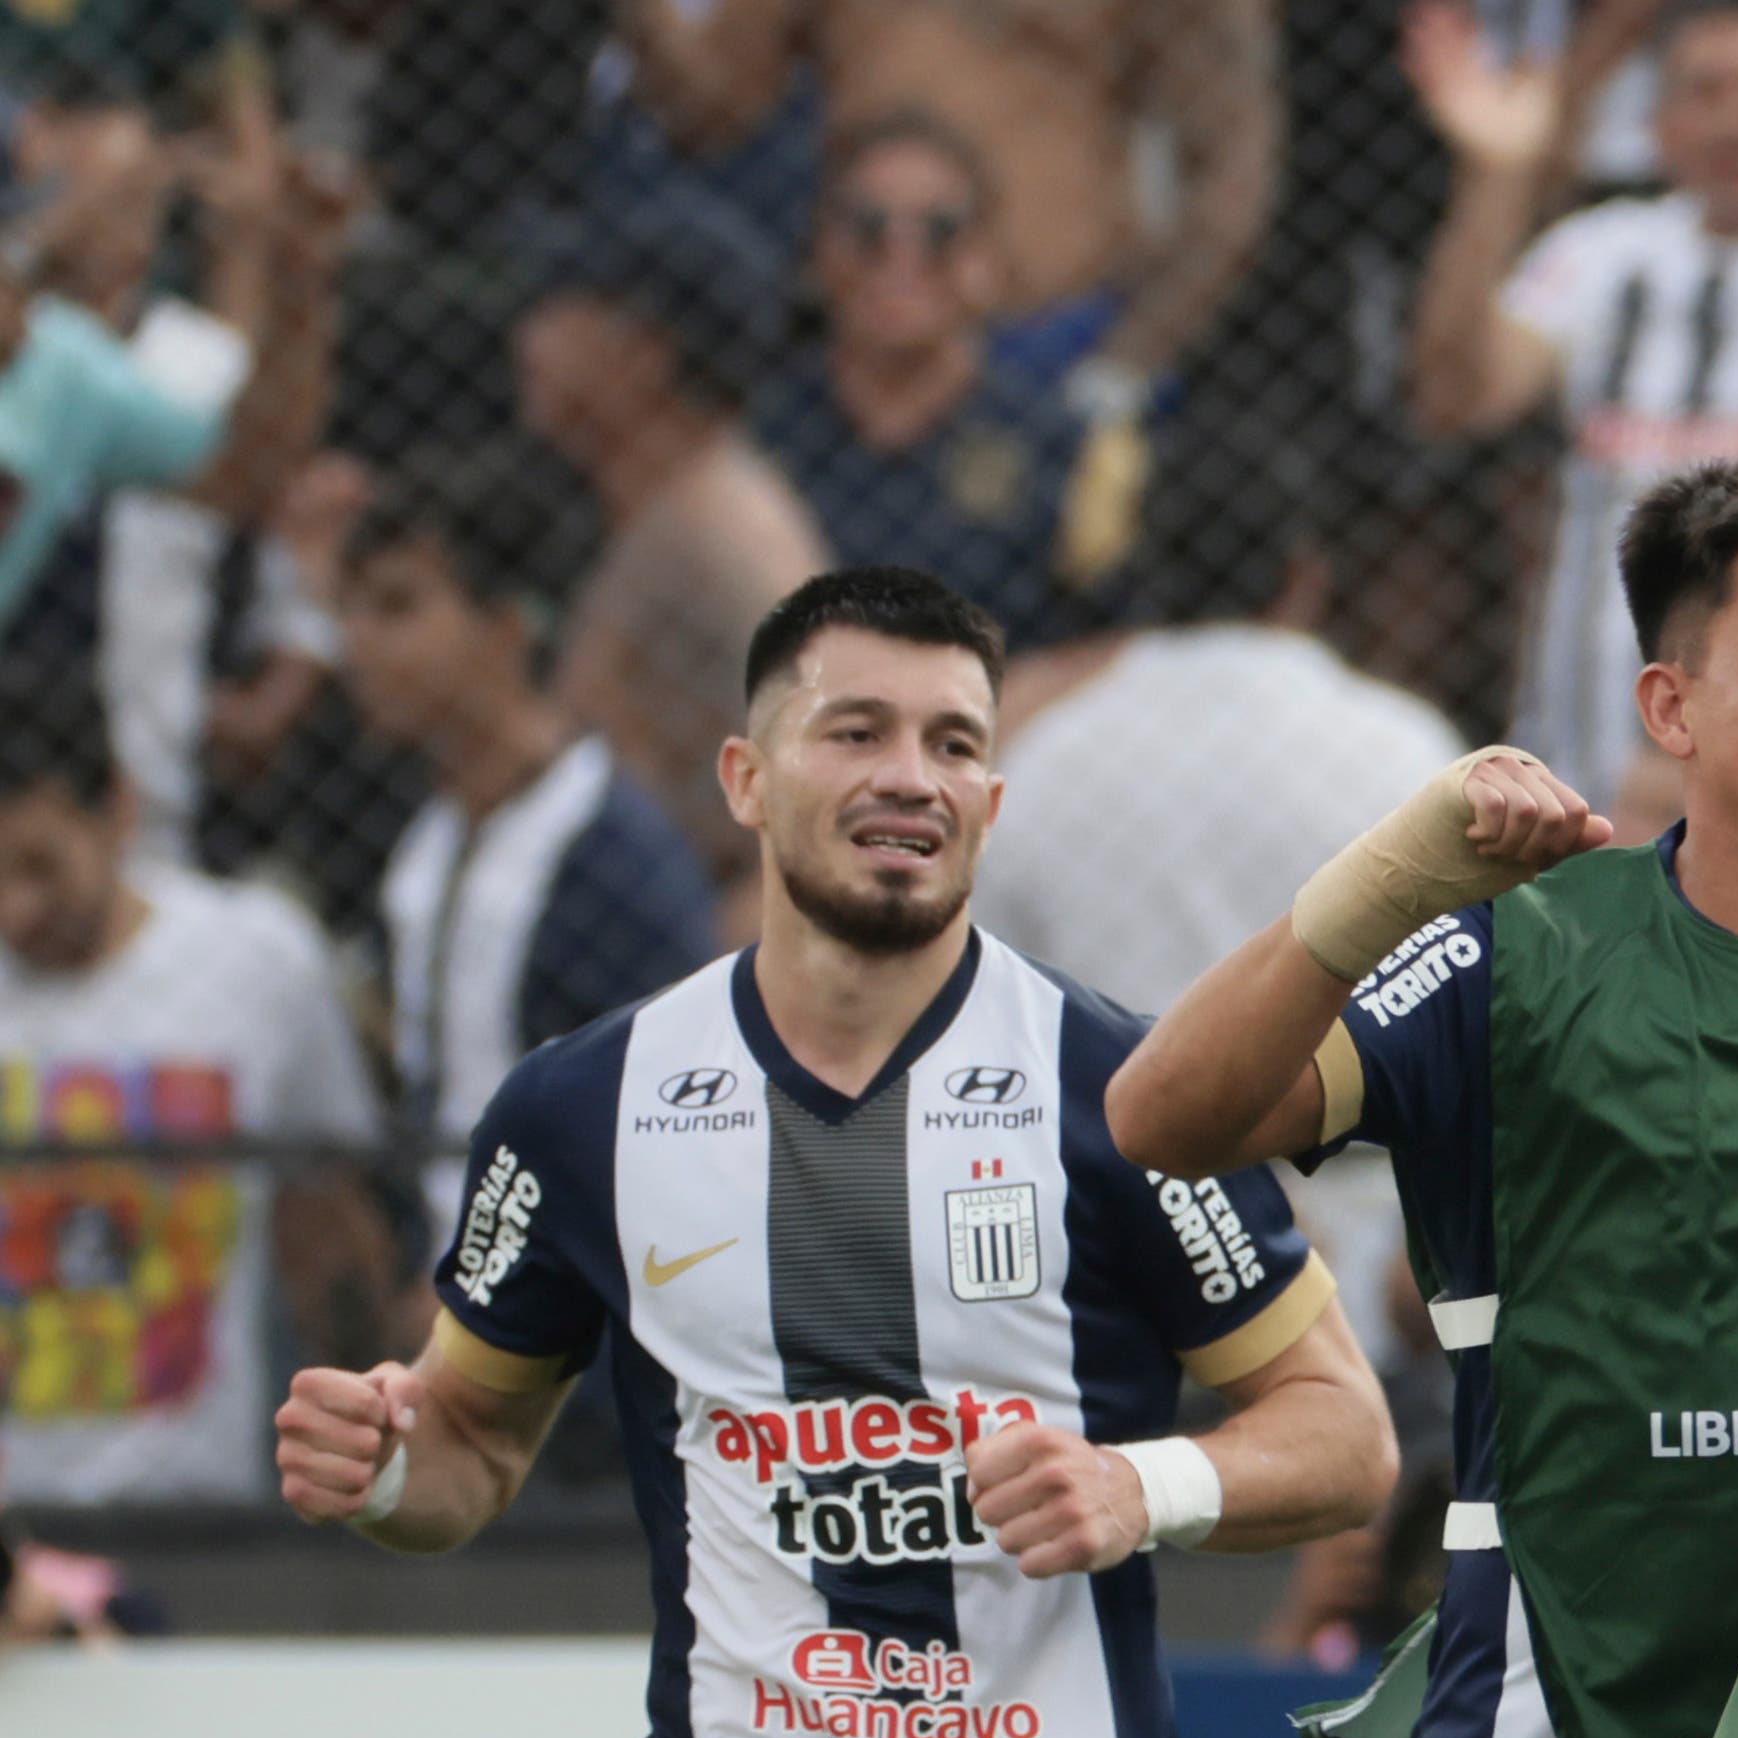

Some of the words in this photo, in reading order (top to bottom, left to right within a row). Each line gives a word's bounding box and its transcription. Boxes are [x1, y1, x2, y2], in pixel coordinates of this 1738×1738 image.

[1357, 933, 1481, 1028] TORITO
[634, 1111, 755, 1133] HYUNDAI
[924, 1107, 1043, 1130] HYUNDAI
[1145, 1169, 1237, 1303] ORITO
[770, 1472, 986, 1557] total
[881, 1642, 971, 1697] Caja
